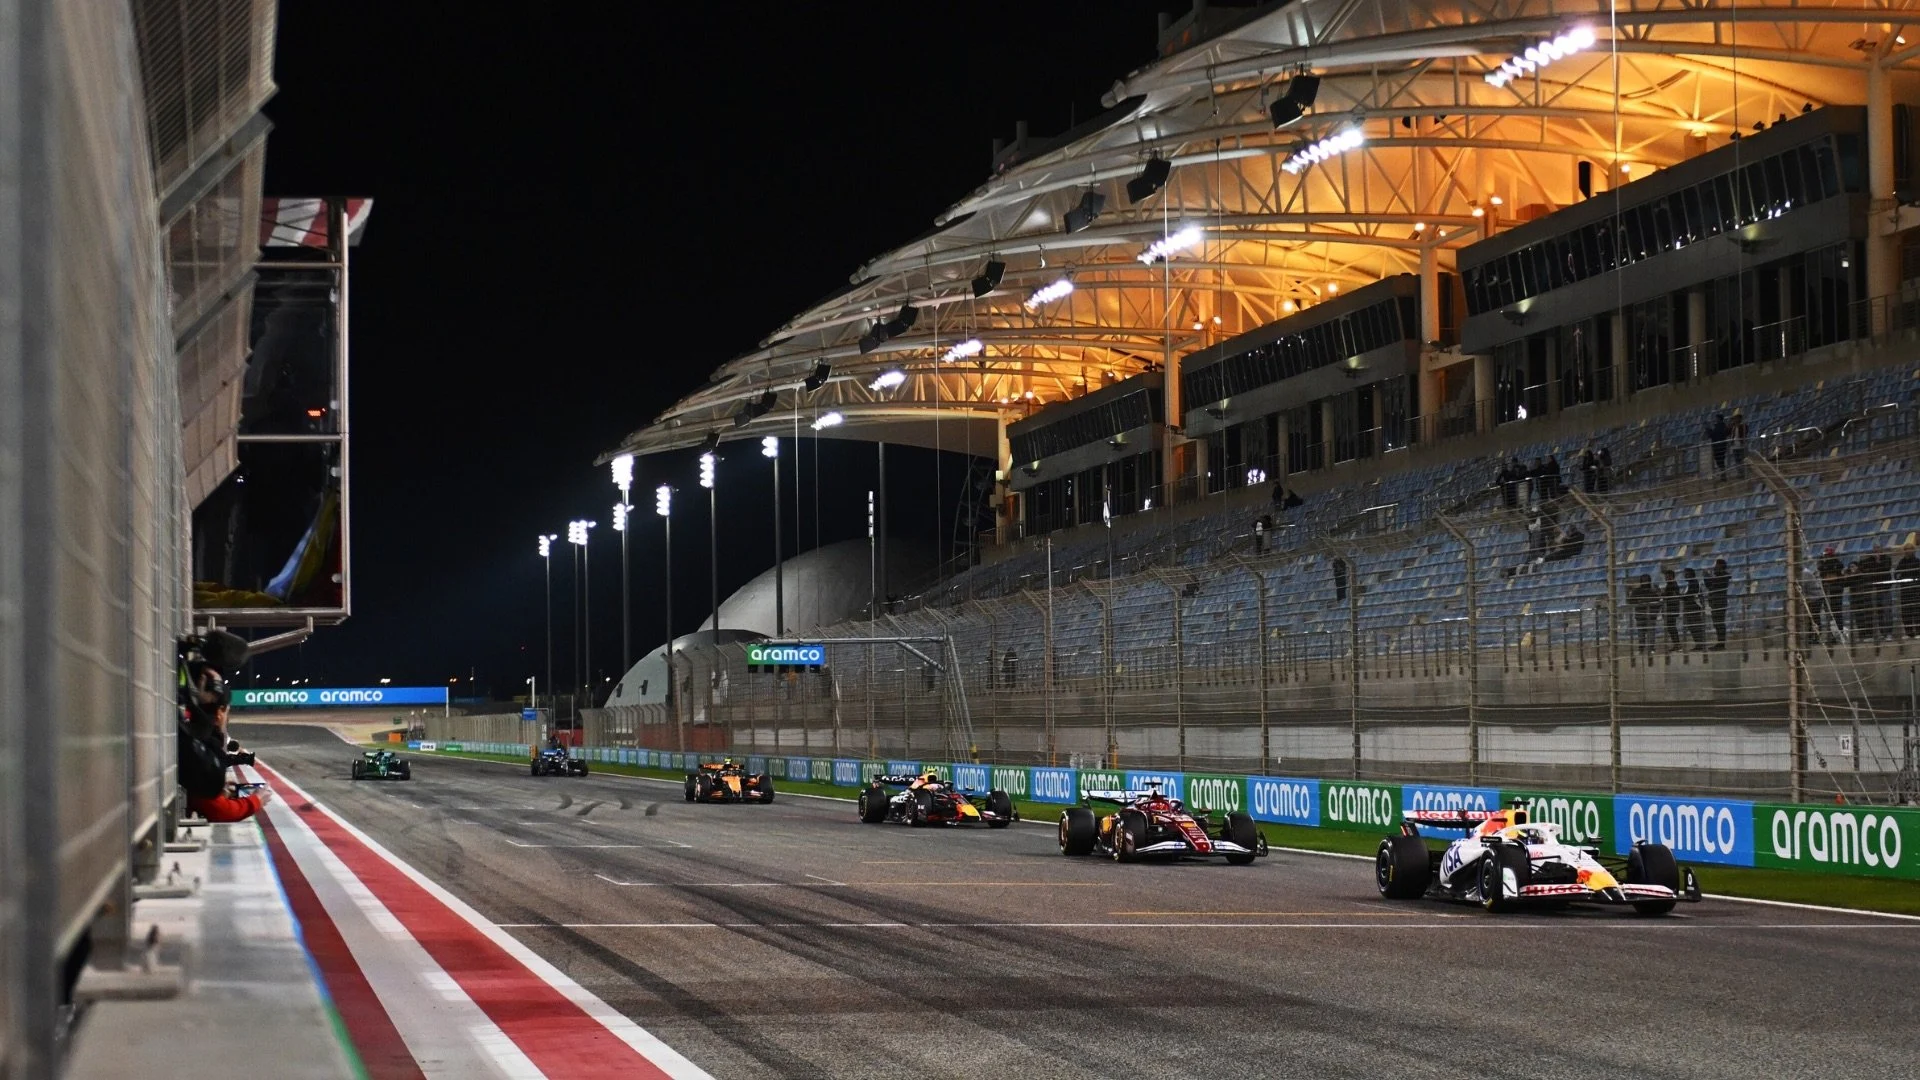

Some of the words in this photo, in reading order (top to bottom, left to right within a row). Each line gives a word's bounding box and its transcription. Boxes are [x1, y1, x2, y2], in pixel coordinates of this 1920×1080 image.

[751, 649, 820, 661] aramco
[245, 691, 308, 703] aramco
[320, 690, 383, 702] aramco
[956, 767, 986, 792] aramco
[993, 768, 1026, 795] aramco
[1035, 770, 1071, 799] aramco
[1190, 778, 1240, 811] aramco
[1254, 782, 1310, 819] aramco
[1328, 785, 1393, 827] aramco
[1629, 802, 1736, 855] aramco
[1772, 809, 1901, 869] aramco
[1524, 885, 1584, 895] HUGO
